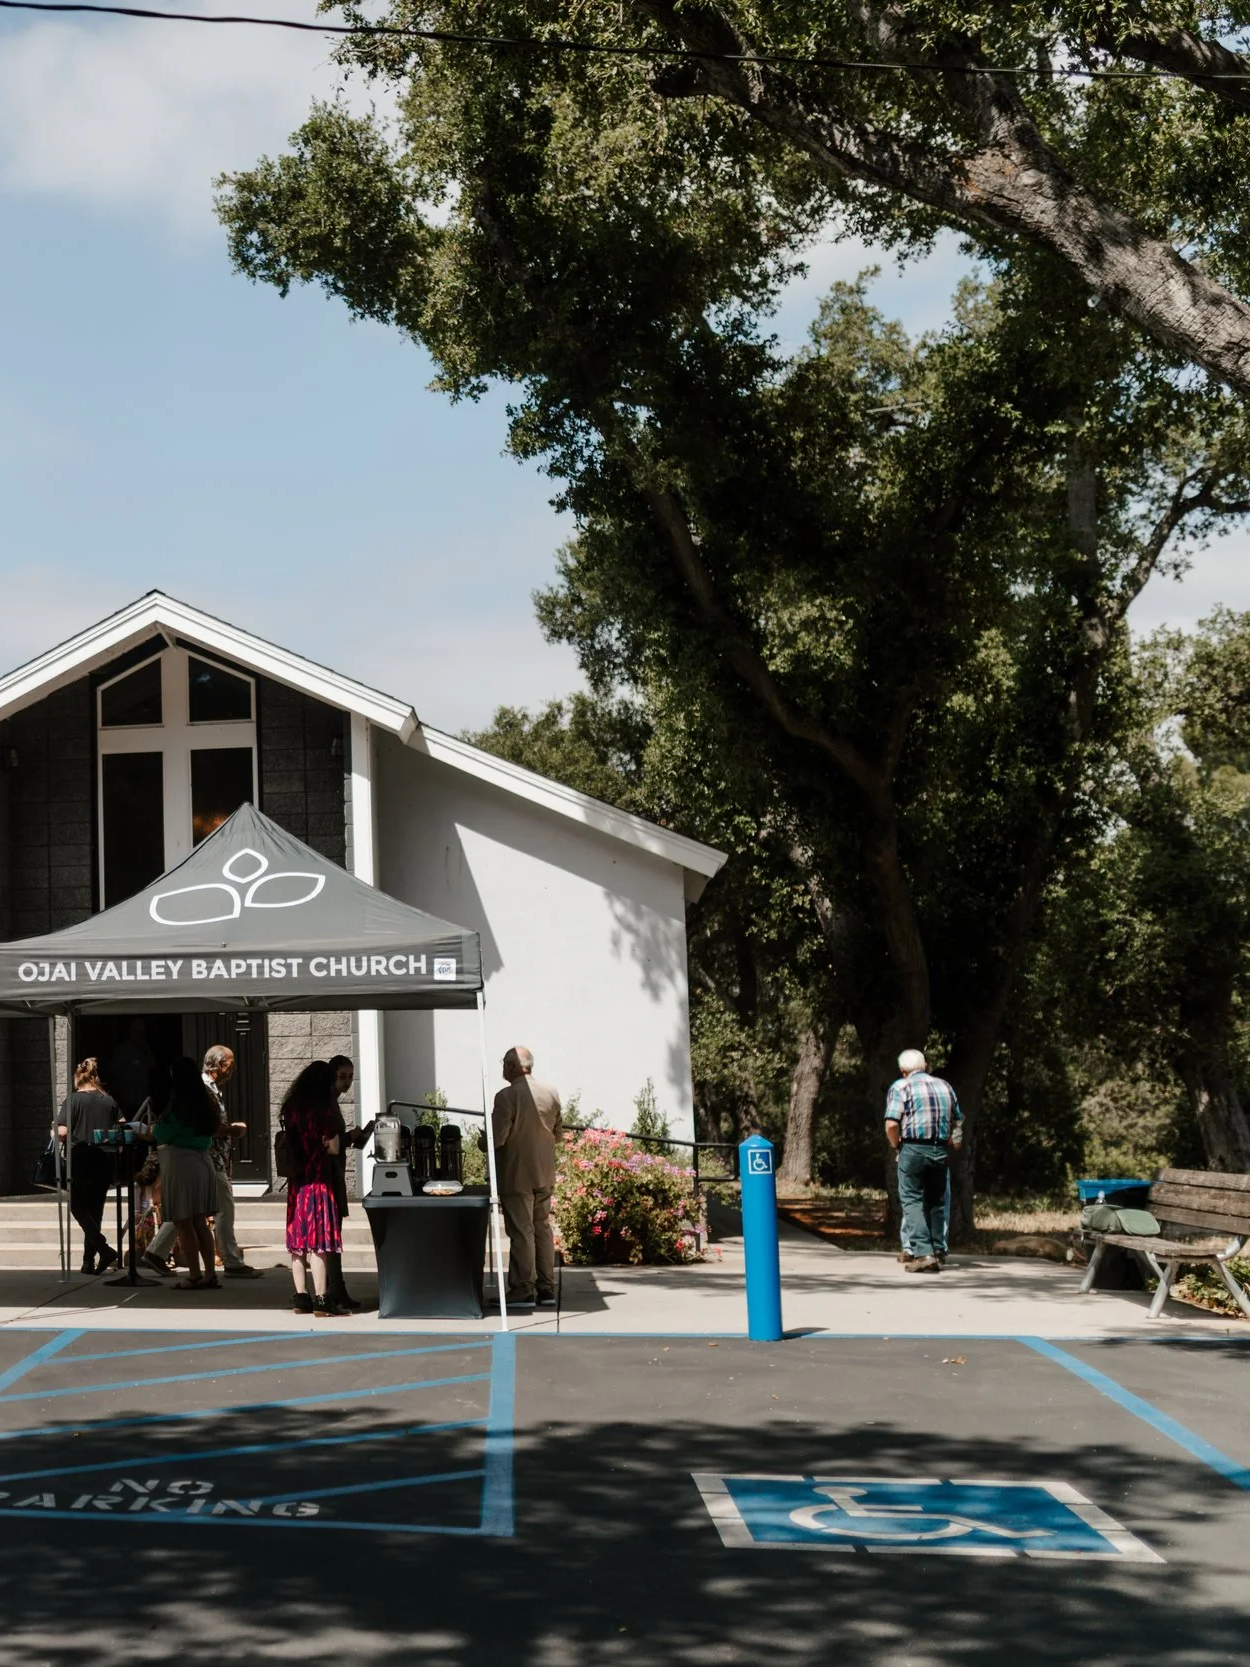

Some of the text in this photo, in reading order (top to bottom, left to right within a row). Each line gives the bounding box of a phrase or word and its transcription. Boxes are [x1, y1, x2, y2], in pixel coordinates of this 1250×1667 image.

[17, 961, 76, 982] OJAI
[84, 959, 184, 981] VALLEY
[191, 957, 303, 979] BAPTIST
[308, 954, 427, 977] CHURCH
[109, 1478, 215, 1495] NO
